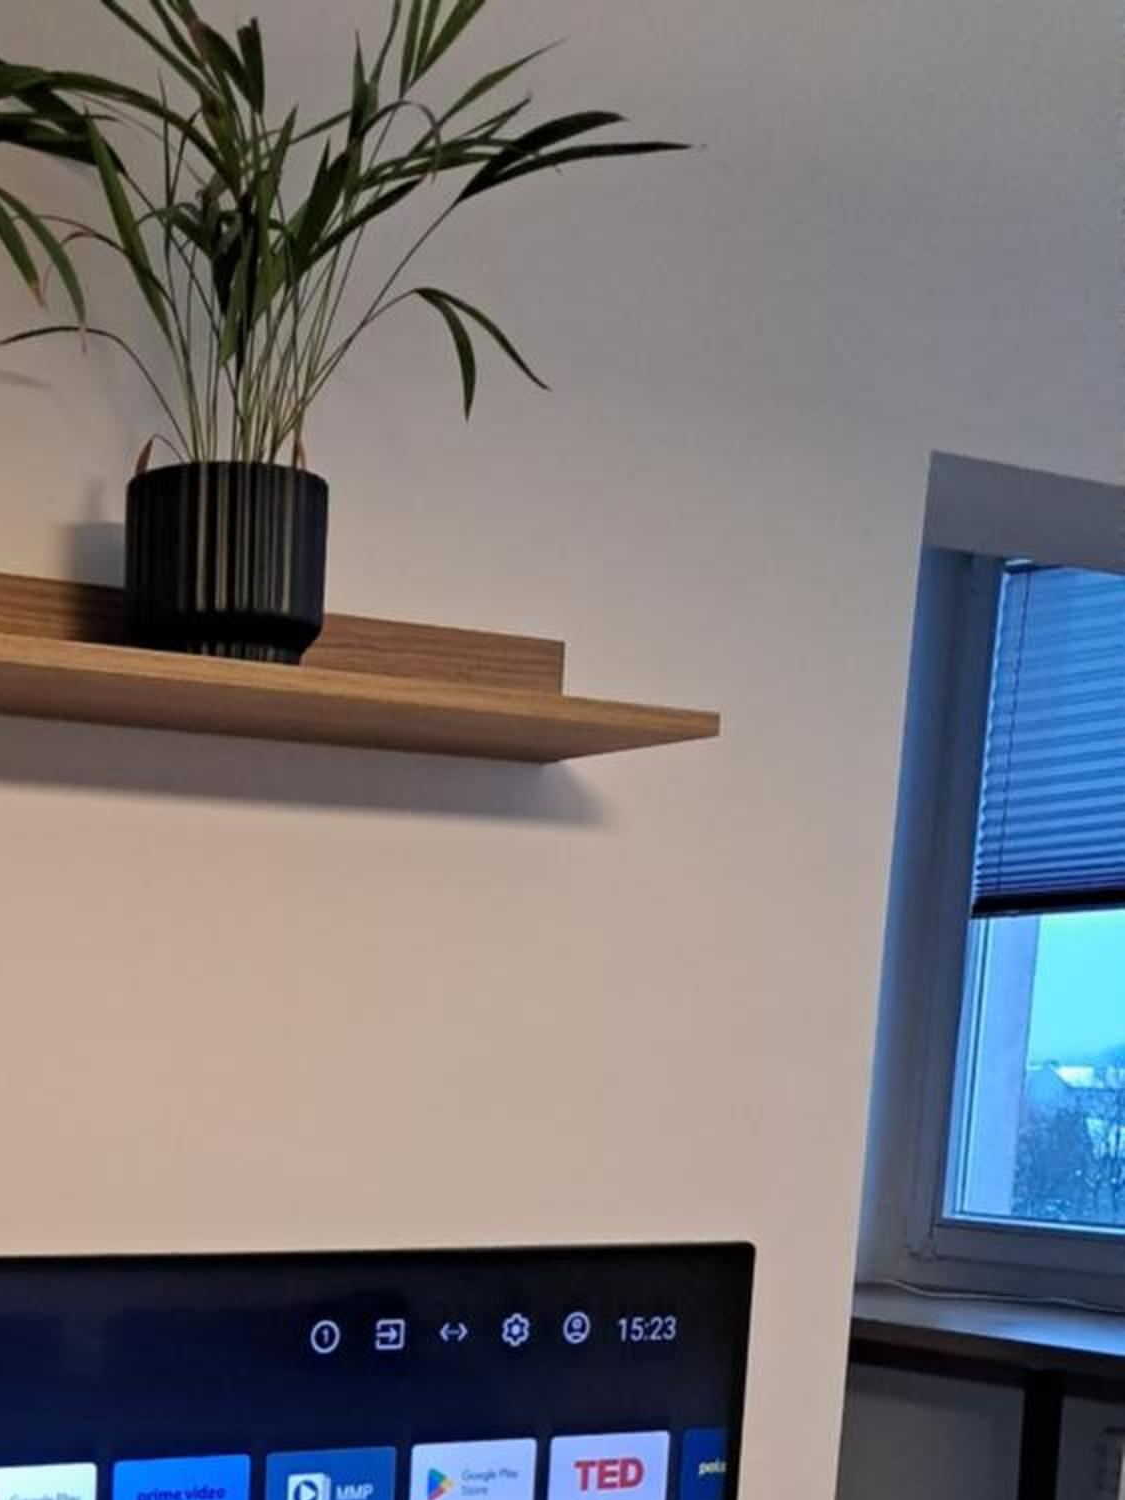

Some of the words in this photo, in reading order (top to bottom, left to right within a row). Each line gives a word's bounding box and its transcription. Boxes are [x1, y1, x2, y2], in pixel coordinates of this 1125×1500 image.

[618, 1316, 677, 1342] 15:23
[461, 1469, 497, 1484] Google
[574, 1456, 645, 1491] TED
[185, 1485, 227, 1500] video
